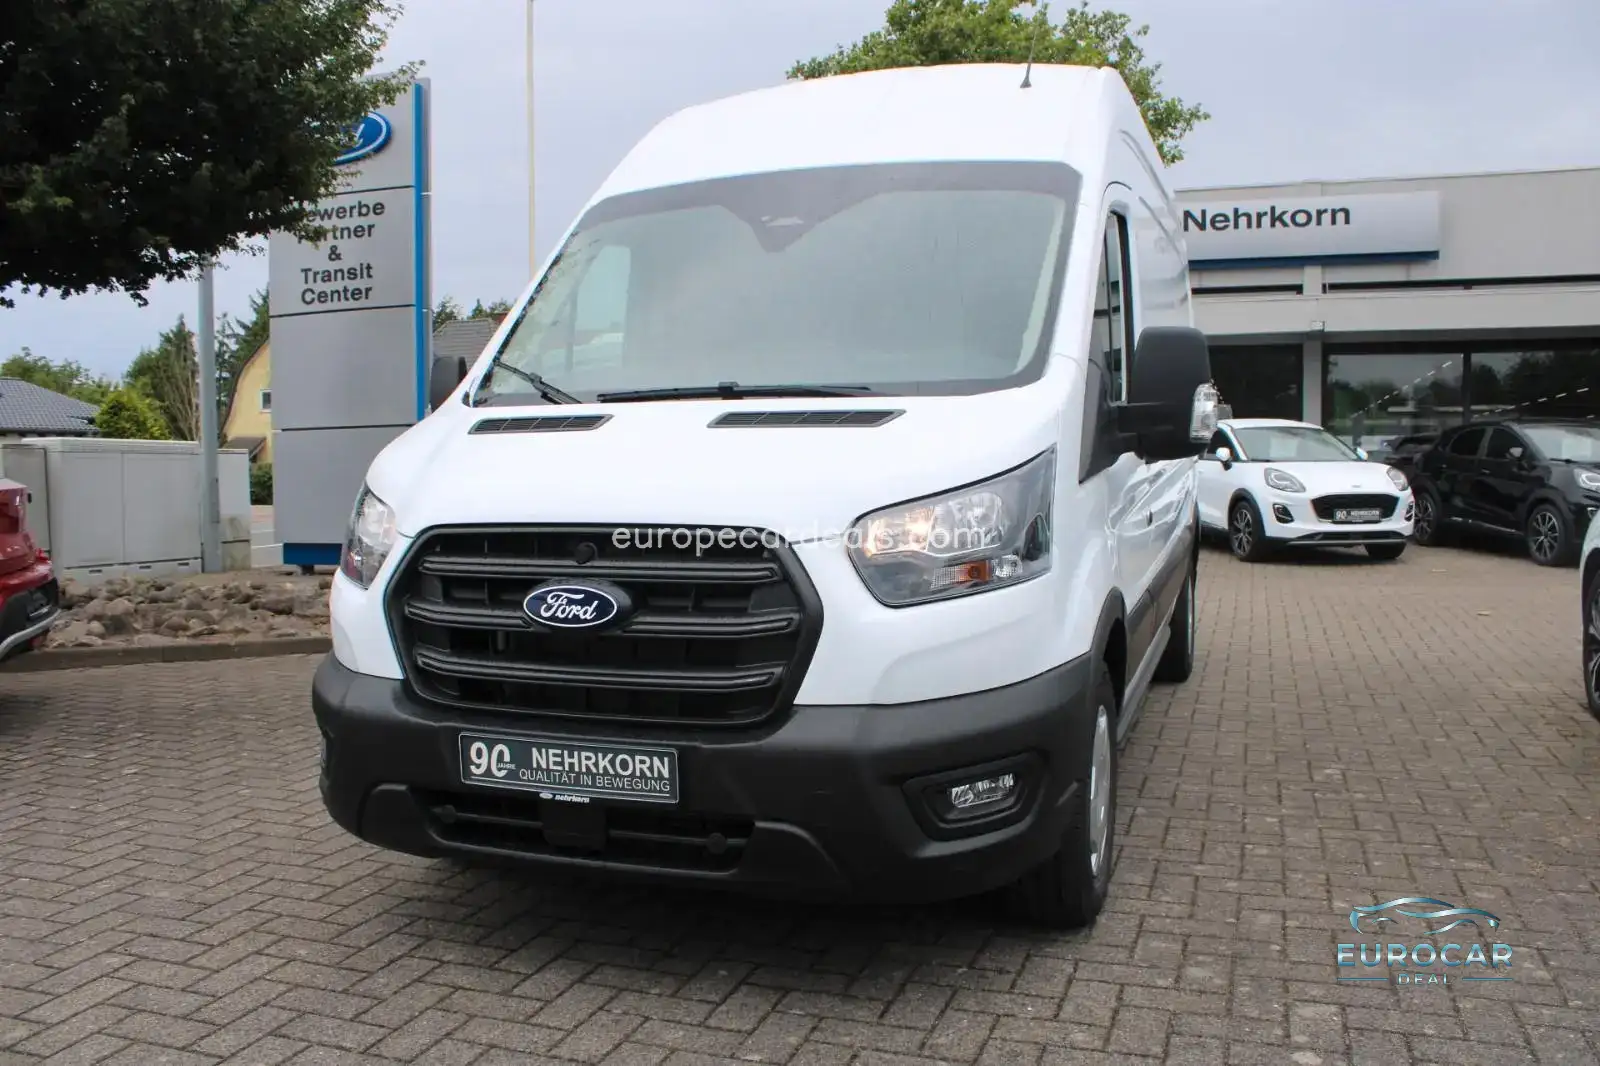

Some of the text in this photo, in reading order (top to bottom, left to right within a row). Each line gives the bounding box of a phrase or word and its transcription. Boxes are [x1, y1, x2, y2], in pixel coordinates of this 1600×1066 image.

[291, 200, 386, 223] ewerbe
[1182, 205, 1351, 232] Nehrkorn
[327, 244, 343, 262] &
[300, 263, 374, 285] Transit
[301, 286, 373, 305] Center
[540, 591, 599, 620] Ford
[469, 741, 511, 778] 90
[531, 747, 671, 779] NEHRKORN
[580, 774, 592, 786] IN
[596, 776, 671, 792] BEWEGUNG
